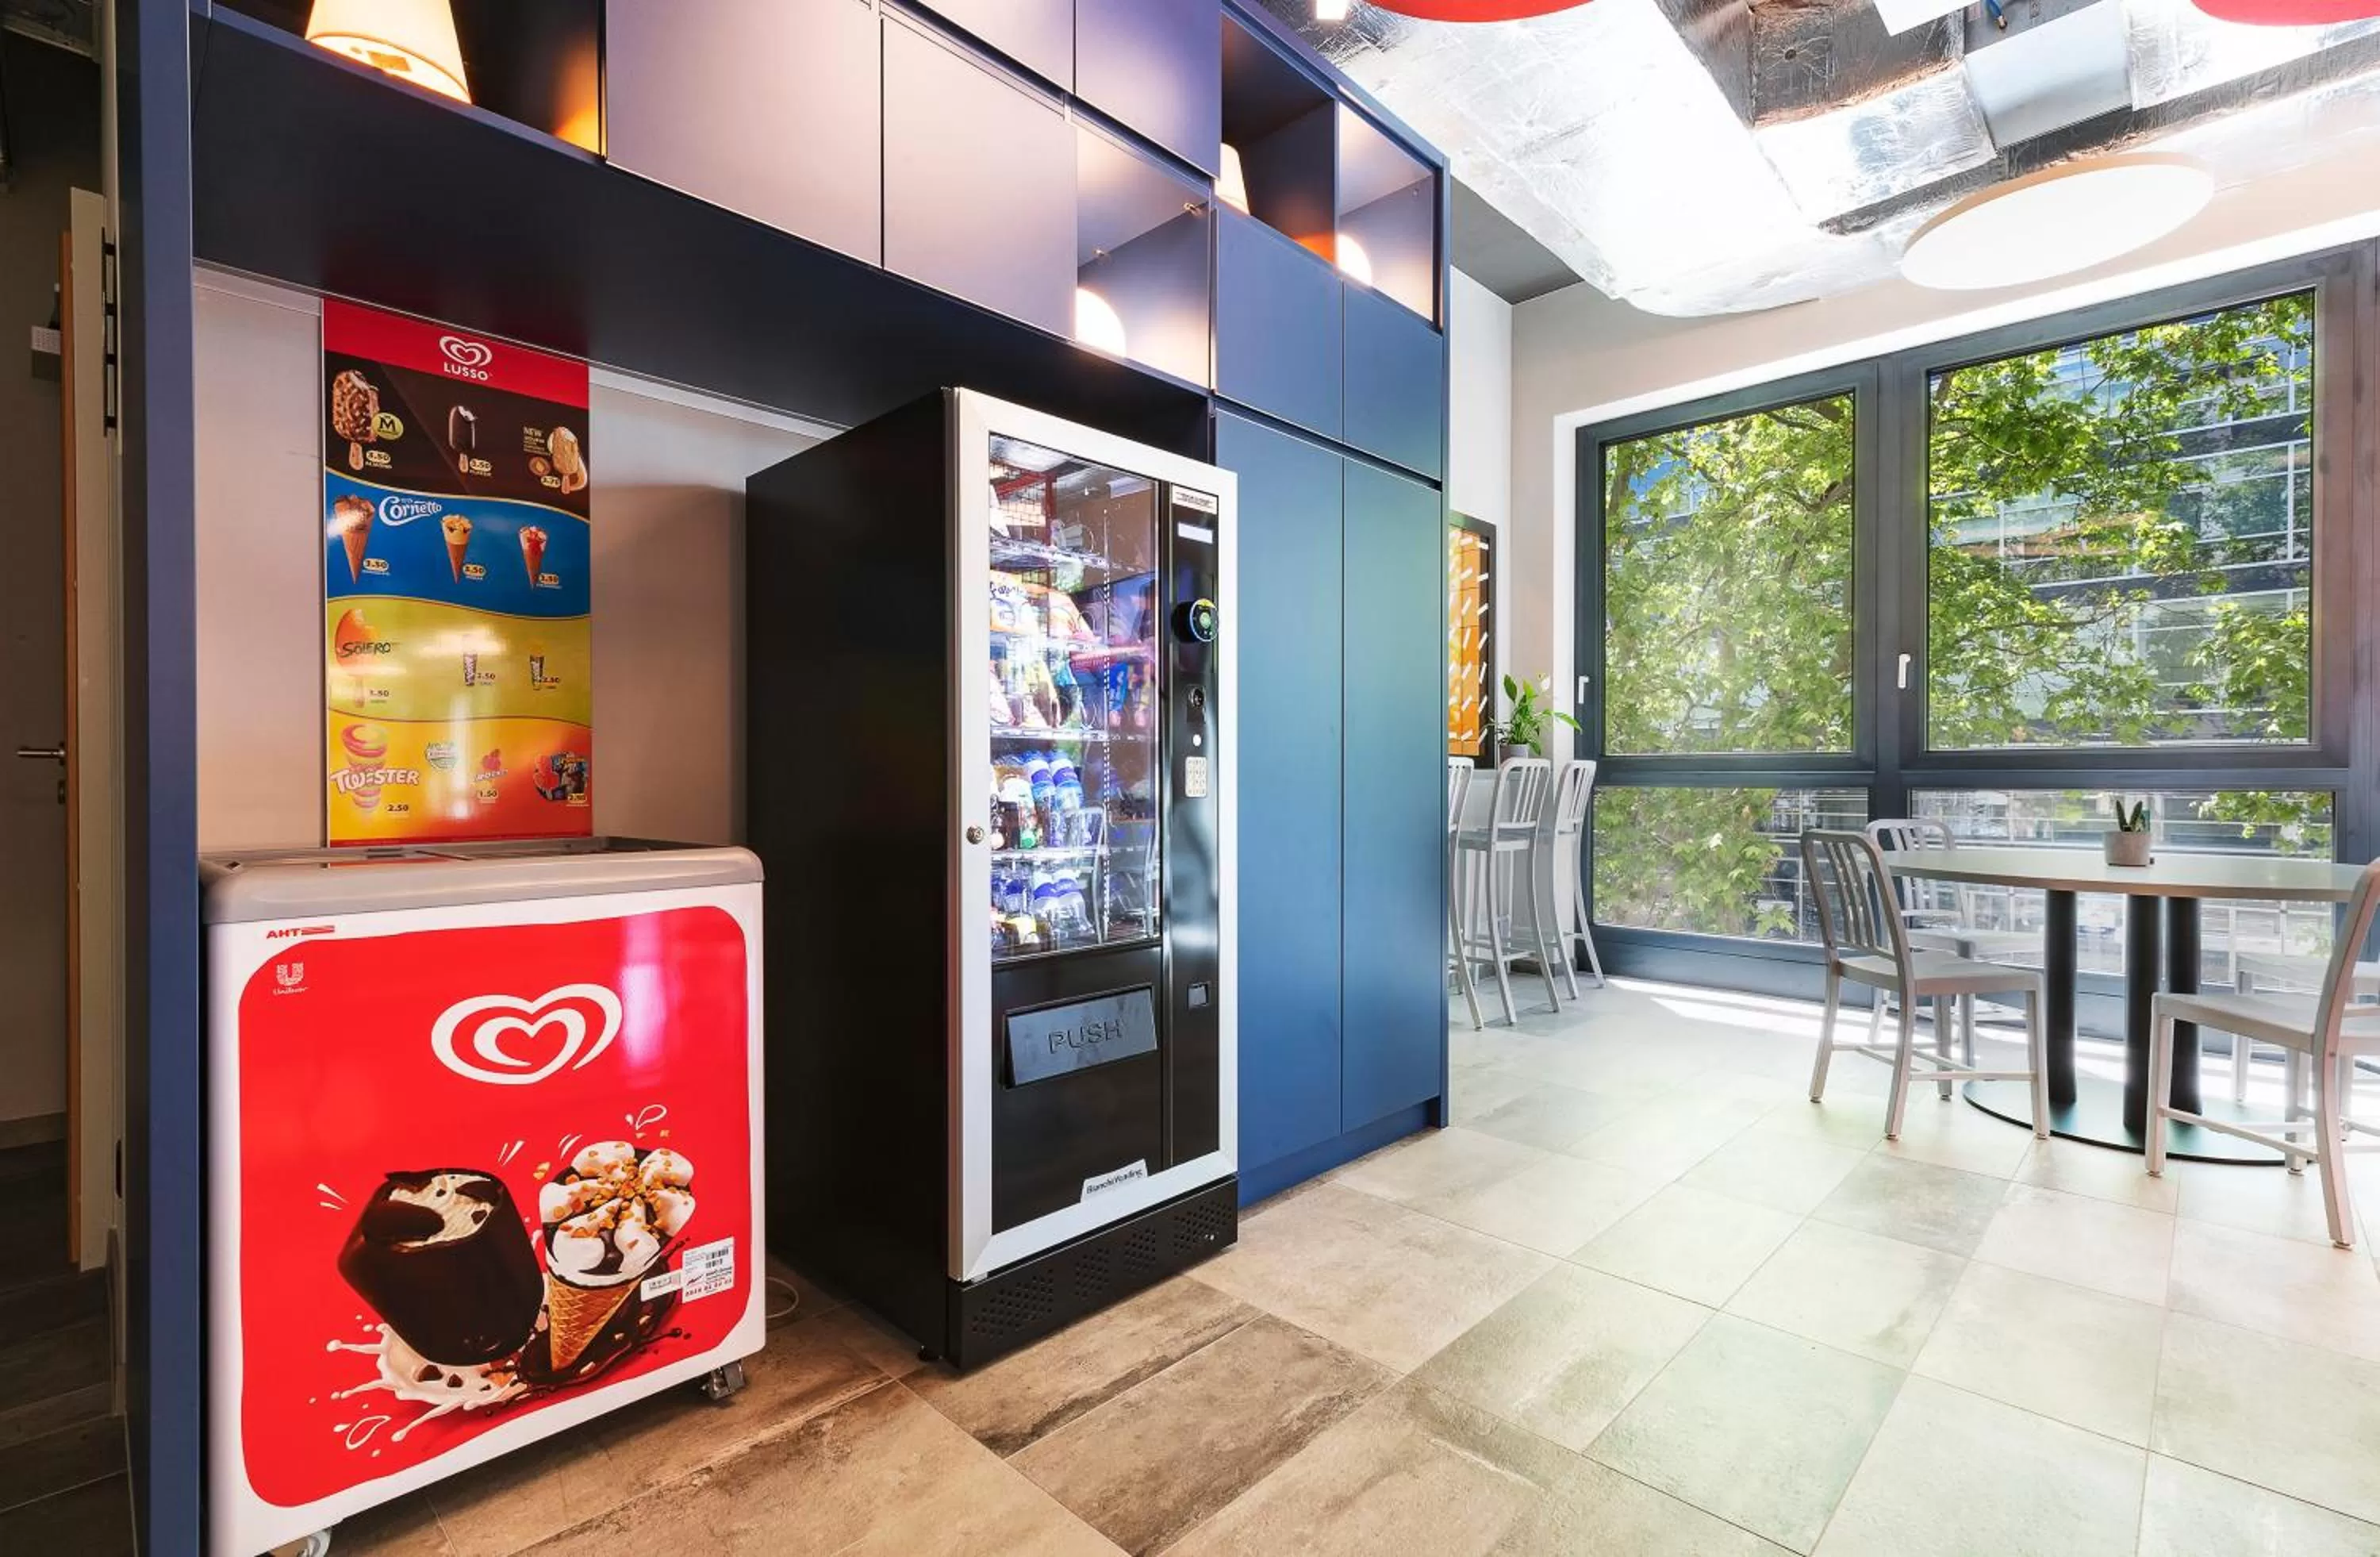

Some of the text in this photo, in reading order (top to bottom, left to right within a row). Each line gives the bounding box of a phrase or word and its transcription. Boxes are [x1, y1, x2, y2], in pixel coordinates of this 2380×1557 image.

[443, 362, 489, 381] LUSSO
[378, 496, 442, 526] Cornetto
[329, 768, 420, 794] TWISTER
[266, 928, 301, 939] AHT
[1047, 1018, 1123, 1055] PUSH
